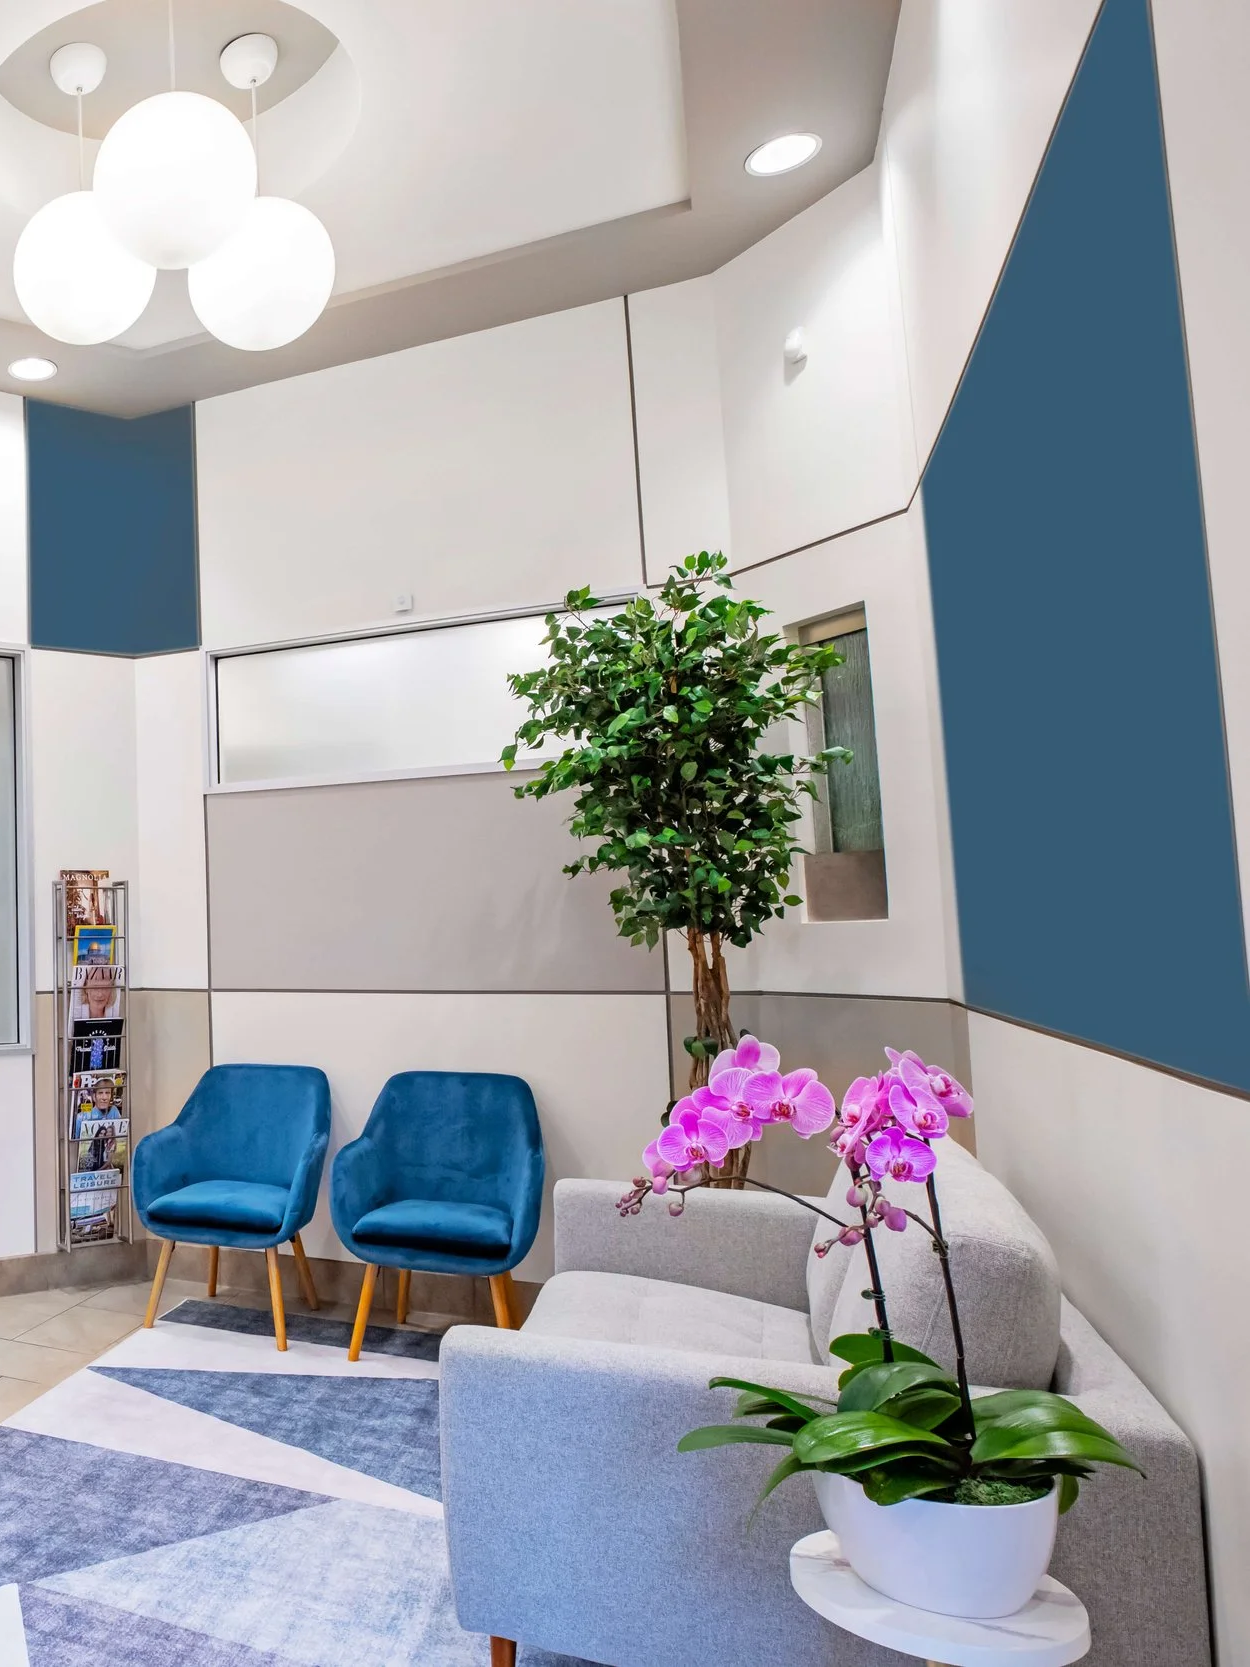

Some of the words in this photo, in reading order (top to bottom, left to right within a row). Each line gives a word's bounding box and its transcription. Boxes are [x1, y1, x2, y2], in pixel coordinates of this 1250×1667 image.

[62, 873, 108, 882] MAGNOLIA
[75, 966, 123, 981] BAZAAR
[83, 1120, 128, 1135] VOE
[73, 1178, 116, 1189] LEISURE
